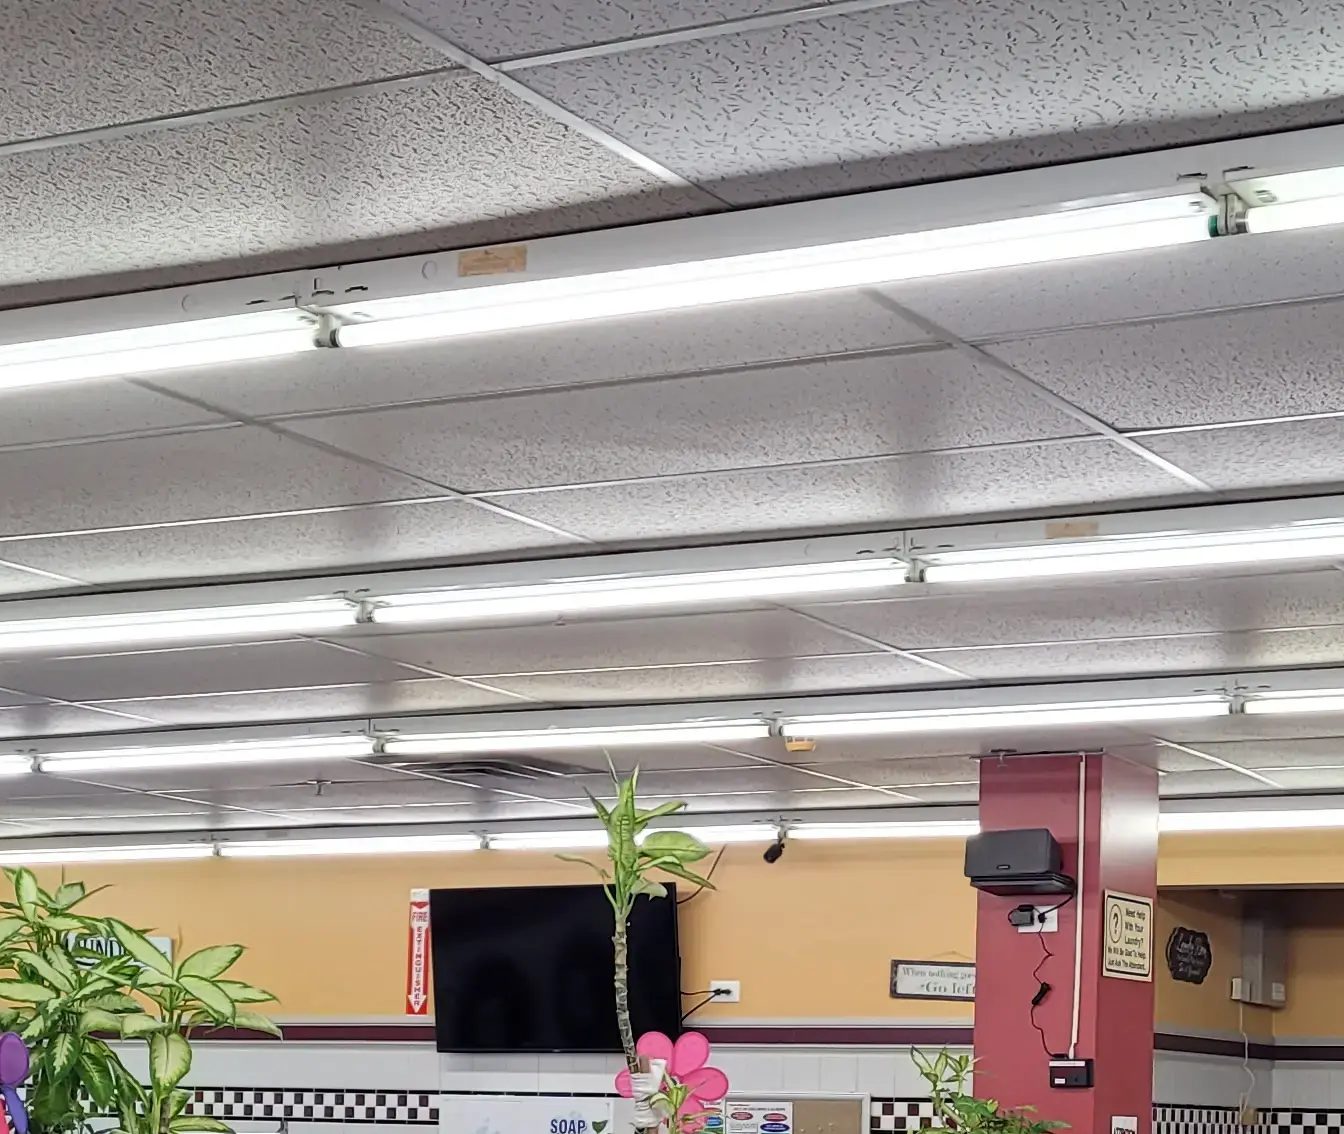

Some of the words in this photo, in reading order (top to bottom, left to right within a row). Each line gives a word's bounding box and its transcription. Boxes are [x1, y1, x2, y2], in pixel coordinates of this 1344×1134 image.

[1126, 908, 1136, 918] Need
[1136, 910, 1146, 921] Help
[1124, 922, 1134, 931] With
[1135, 924, 1144, 932] Your
[1124, 936, 1144, 948] Laundry?
[414, 926, 422, 1006] EXTINGUISHER
[903, 967, 926, 976] When
[928, 970, 959, 979] nothing
[960, 972, 975, 980] goe
[550, 1118, 586, 1134] SOAP
